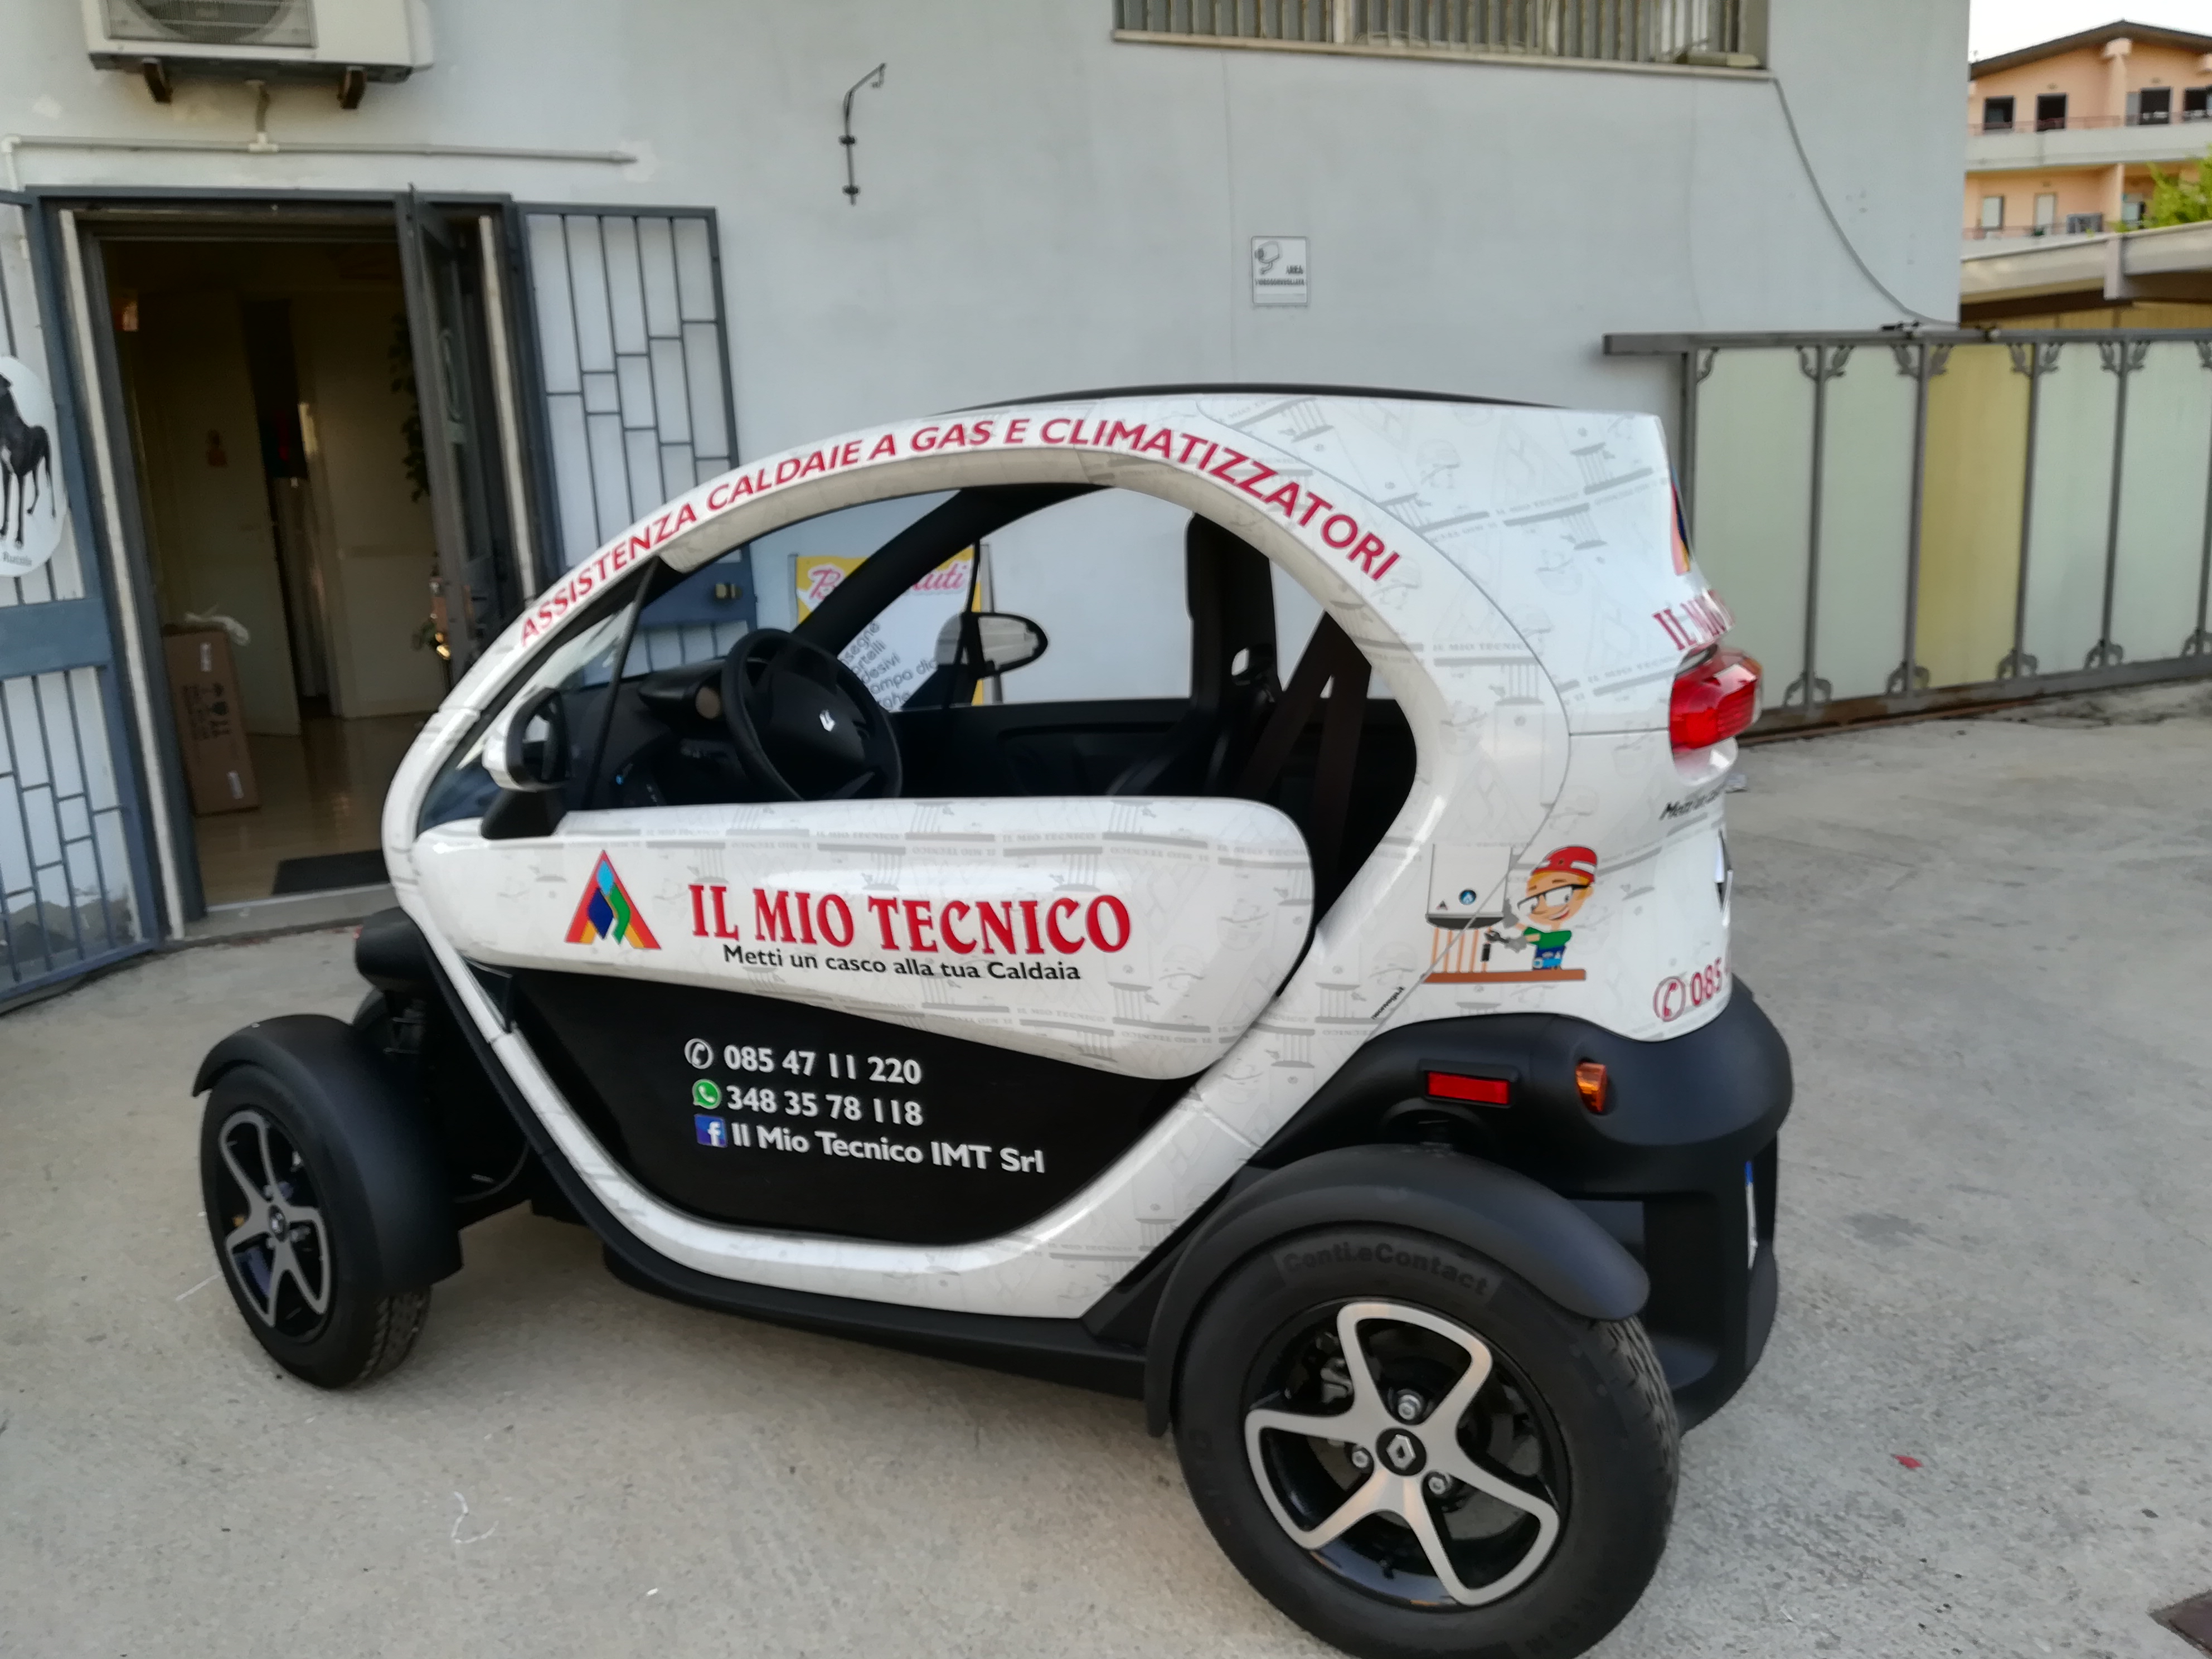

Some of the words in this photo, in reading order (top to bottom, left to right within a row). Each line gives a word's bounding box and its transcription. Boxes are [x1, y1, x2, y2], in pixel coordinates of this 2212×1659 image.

[521, 503, 697, 646] ASSISTENZA
[706, 439, 863, 512] CALDAIE
[869, 434, 895, 461] A
[910, 420, 993, 452] GAS
[1002, 419, 1031, 445] E
[1040, 418, 1401, 583] CLIMATIZZATORI
[688, 884, 739, 941] IL
[753, 888, 855, 948] MIO
[867, 894, 1131, 955] TECNICO
[723, 944, 783, 967] Metti
[789, 955, 817, 969] un
[825, 956, 886, 973] casco
[892, 958, 934, 977] alla
[940, 962, 981, 978] tua
[987, 961, 1081, 980] Caldaia
[723, 1044, 775, 1073] 085
[782, 1049, 816, 1076] 47
[828, 1052, 857, 1080] 11
[867, 1056, 923, 1085] 220
[726, 1085, 778, 1114] 348
[784, 1090, 818, 1117] 35
[825, 1094, 862, 1122] 78
[873, 1098, 924, 1126] 118
[756, 1125, 810, 1153] Mio
[814, 1130, 923, 1165] Tecnico
[930, 1141, 992, 1170] IMT
[999, 1148, 1045, 1173] Srl
